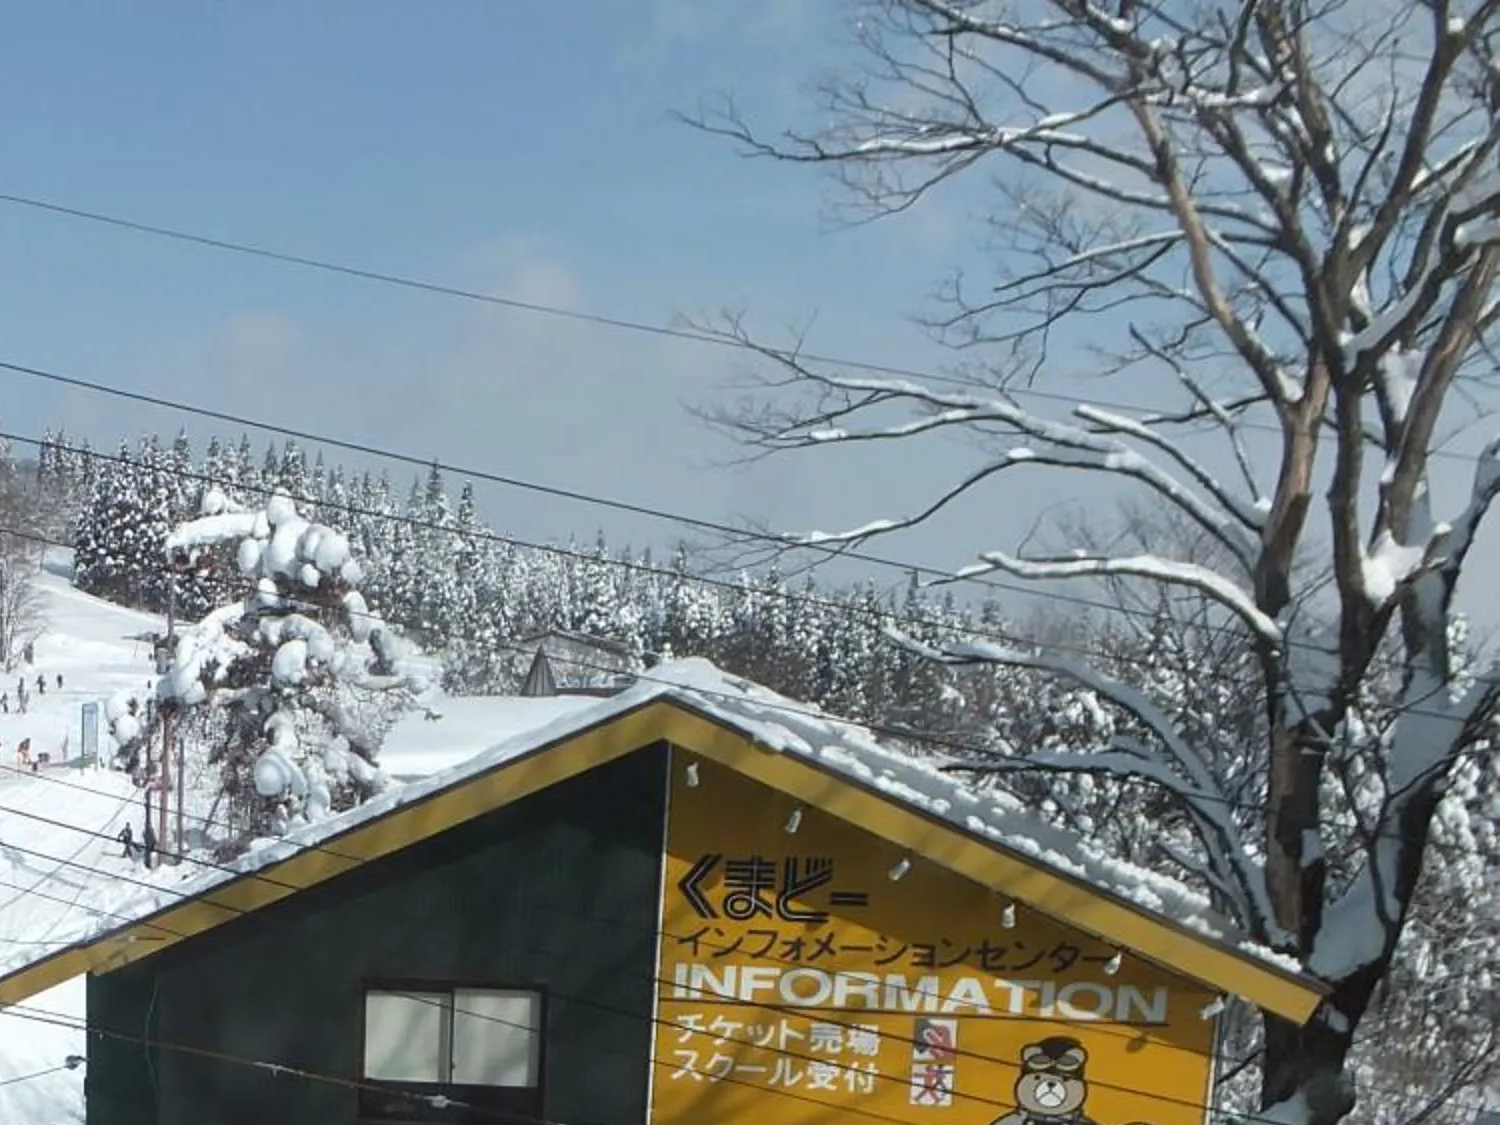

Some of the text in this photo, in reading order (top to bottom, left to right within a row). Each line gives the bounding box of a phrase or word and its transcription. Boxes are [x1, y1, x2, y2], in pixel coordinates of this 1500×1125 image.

[677, 853, 869, 922] くまどー
[678, 927, 1110, 973] インフォメーションセンター
[673, 962, 1169, 1025] INFORMATION
[675, 1013, 881, 1057] チケット売場
[670, 1049, 880, 1094] スクール受付
